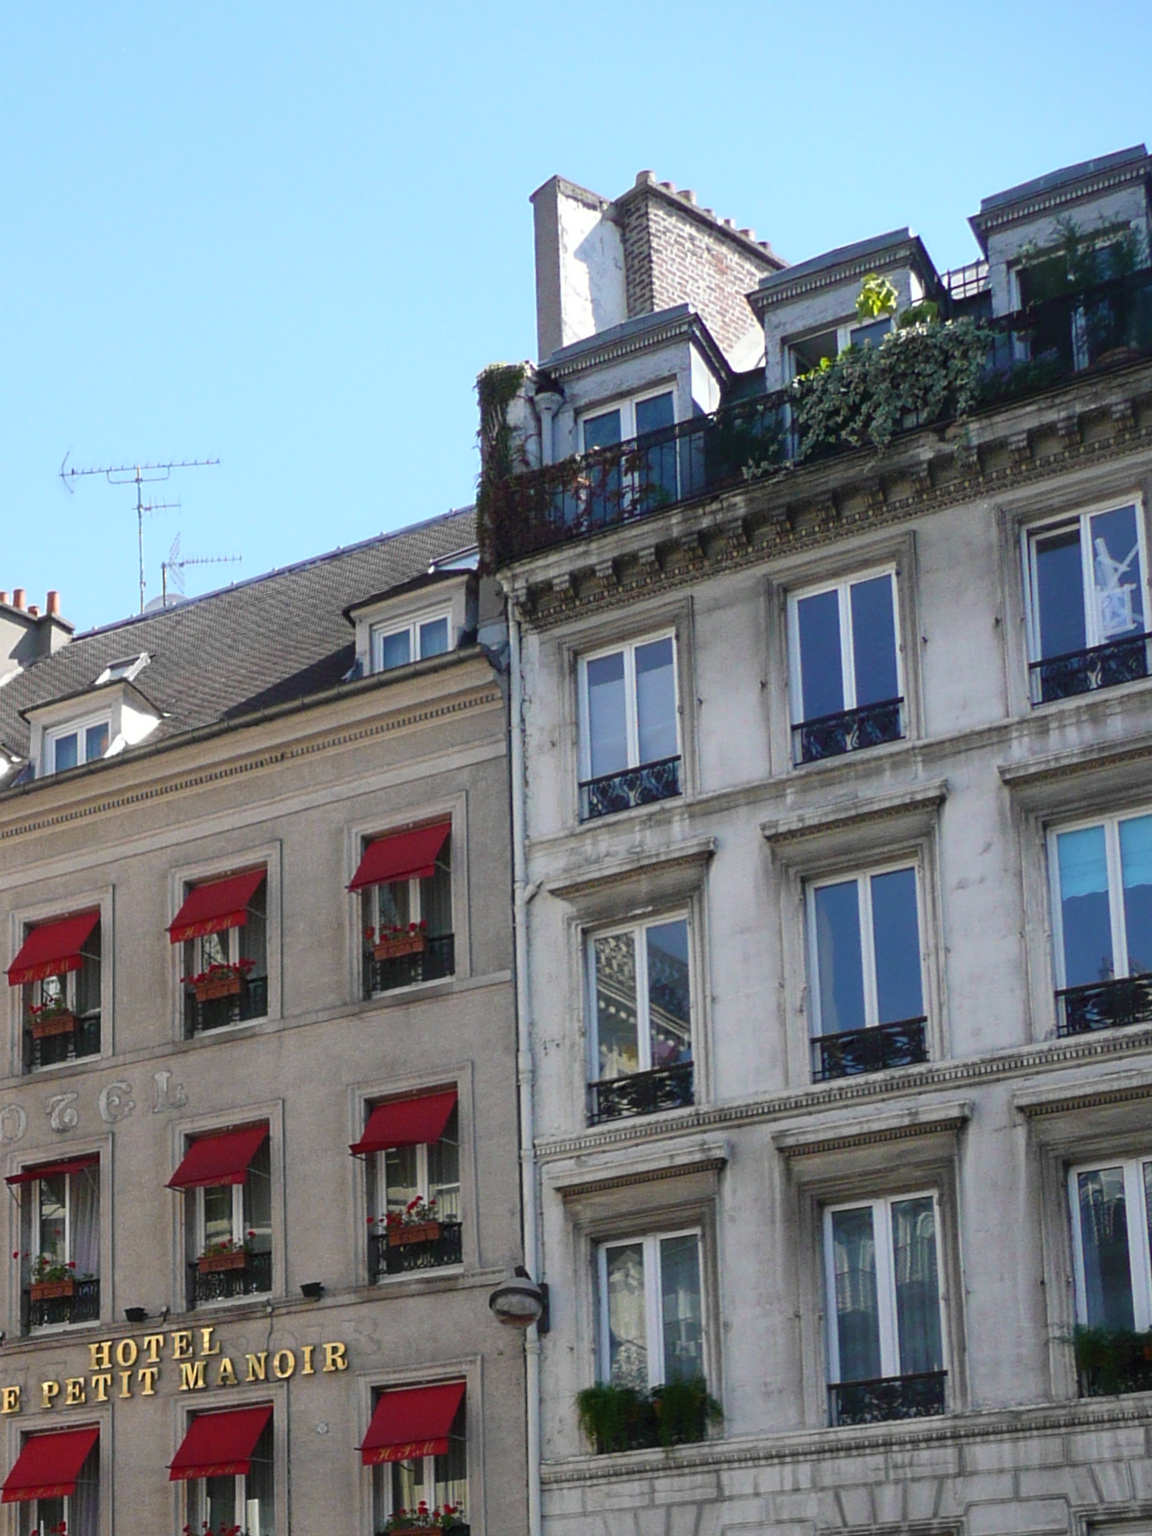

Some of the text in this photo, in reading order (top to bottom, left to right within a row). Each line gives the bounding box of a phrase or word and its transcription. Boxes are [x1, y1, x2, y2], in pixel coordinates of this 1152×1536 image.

[41, 1366, 159, 1409] PETIT
[179, 1341, 349, 1391] MANOIR
[87, 1326, 222, 1371] HOTEL
